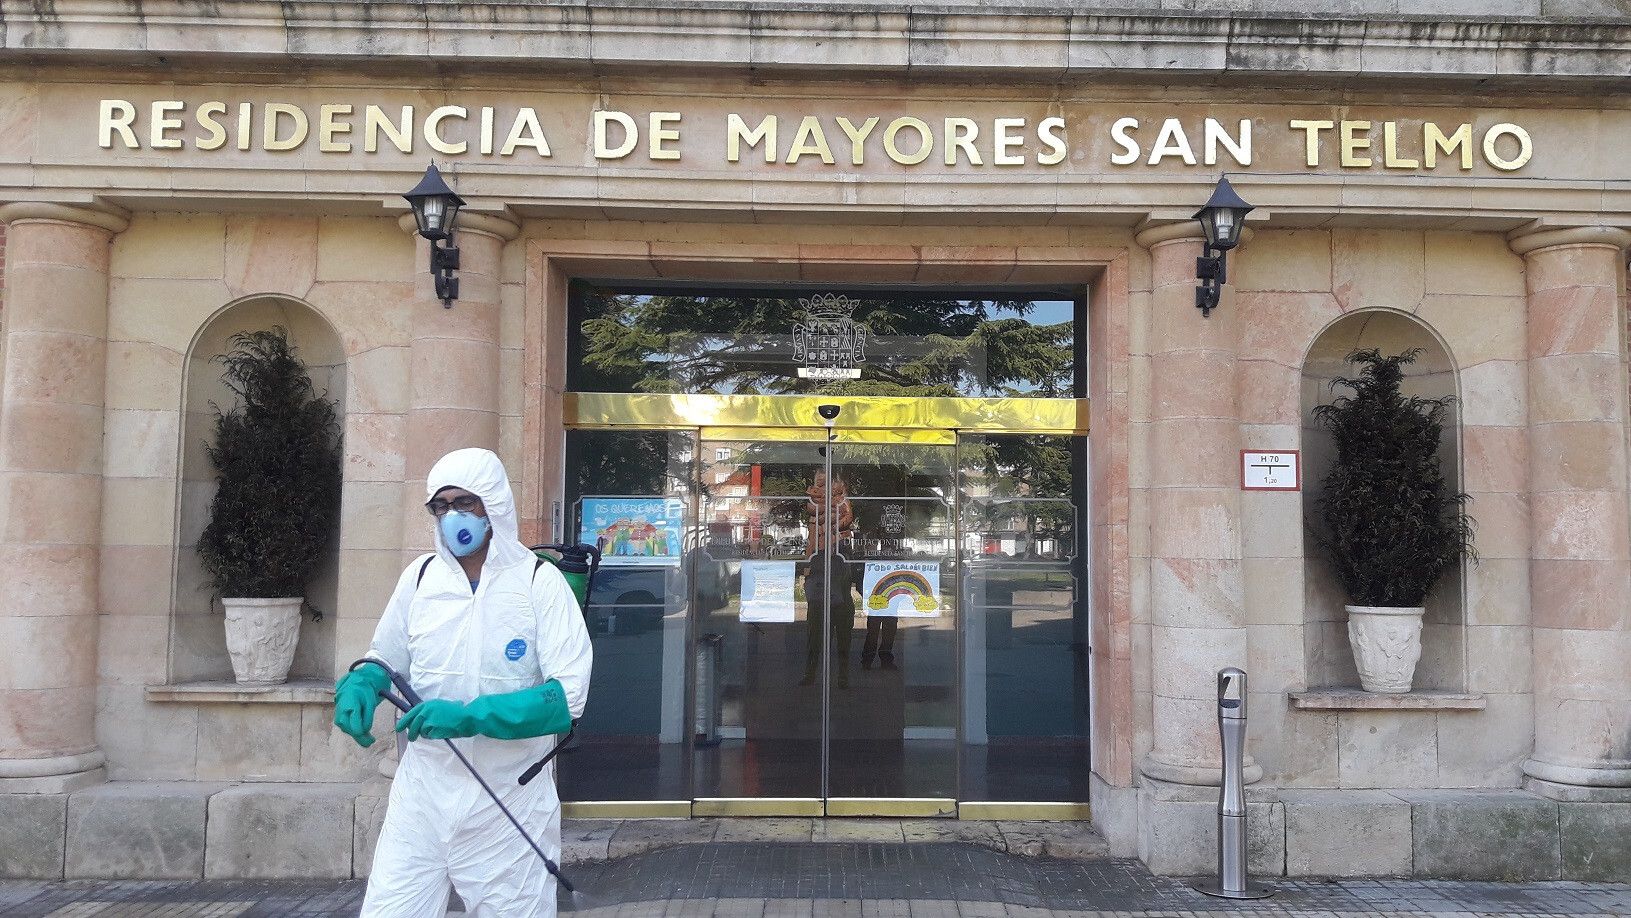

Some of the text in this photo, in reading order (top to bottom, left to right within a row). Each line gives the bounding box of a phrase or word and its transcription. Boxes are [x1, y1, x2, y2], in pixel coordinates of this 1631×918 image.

[97, 99, 1534, 171] RESIDENCIA DE MAYORES SAN TELMO
[866, 563, 892, 572] TODO
